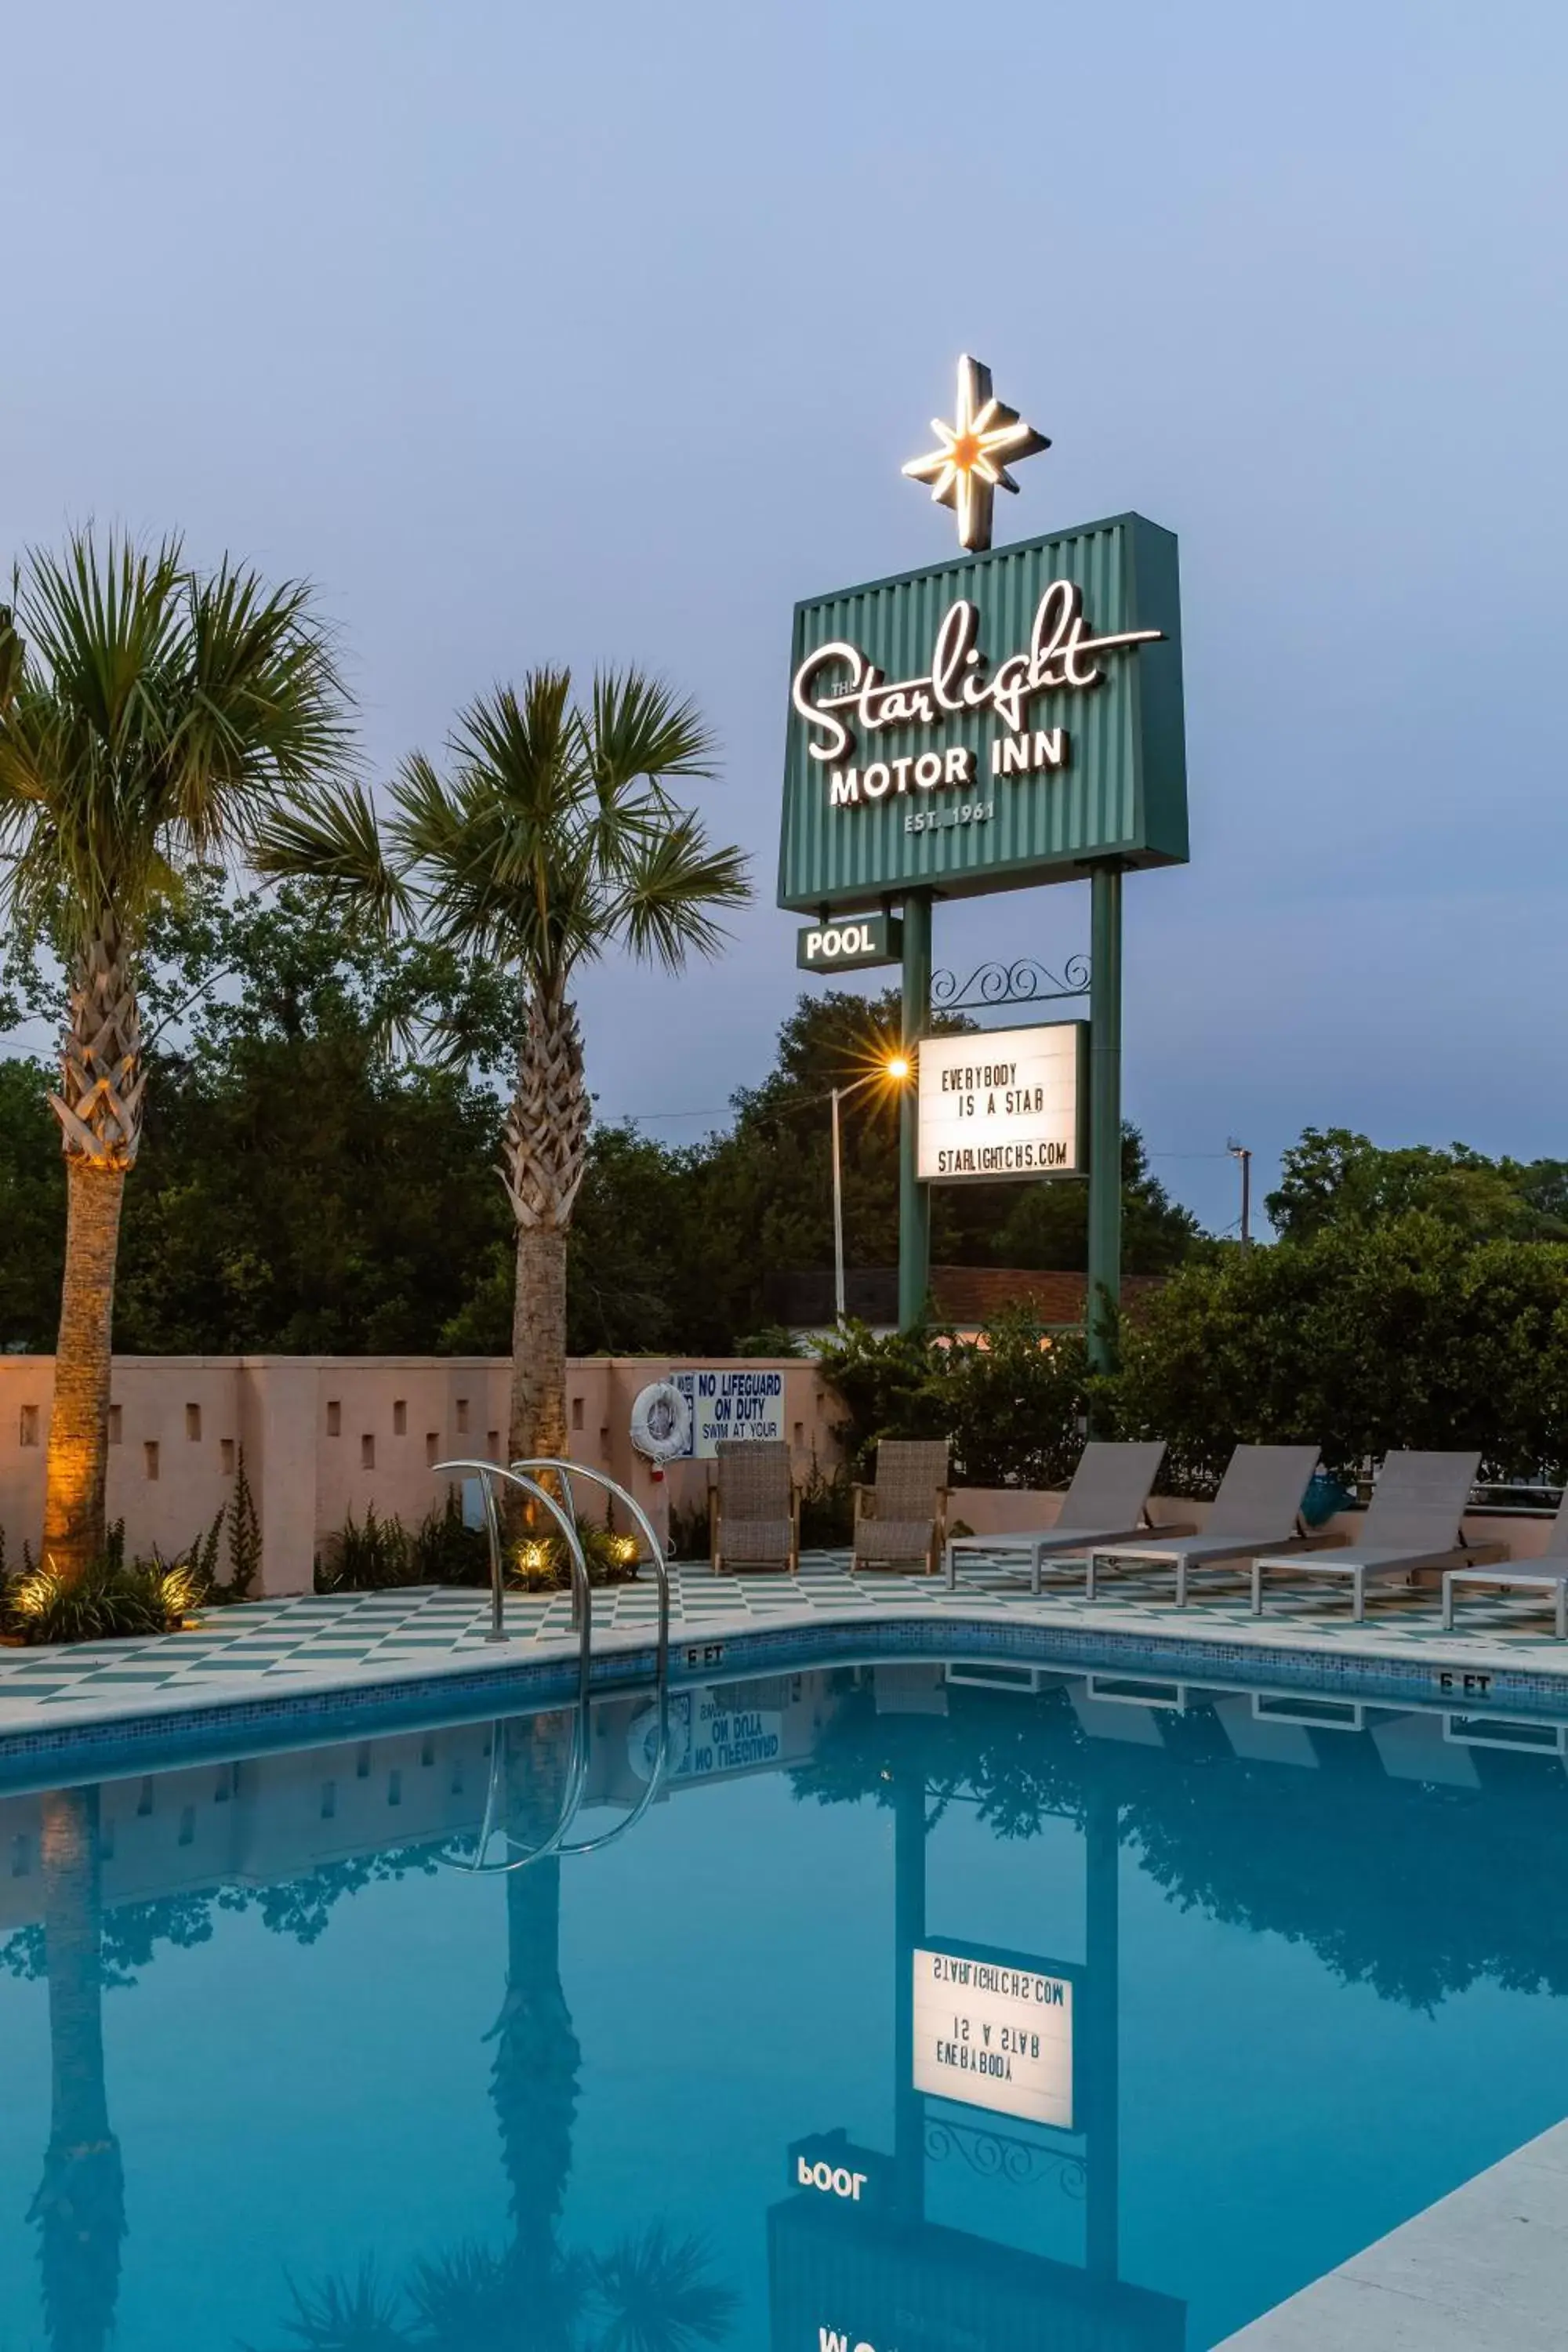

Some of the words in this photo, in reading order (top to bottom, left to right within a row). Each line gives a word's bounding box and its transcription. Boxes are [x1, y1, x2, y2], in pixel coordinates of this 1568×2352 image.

[793, 579, 1162, 760] Starlight
[829, 746, 969, 806] MOTOR
[992, 728, 1062, 775] INN
[905, 811, 942, 833] EST.
[953, 800, 995, 824] 1961
[807, 924, 876, 960] POOL
[942, 1062, 1017, 1092] EVERYBODY
[959, 1094, 975, 1117] IS
[987, 1092, 996, 1114] A
[1005, 1087, 1044, 1115] STAR
[938, 1141, 1067, 1174] STARLIGHTCHS.COM
[699, 1374, 716, 1397] NO
[722, 1374, 782, 1396] LIFEGUARD
[714, 1398, 731, 1421] ON
[736, 1397, 766, 1420] DUTY
[702, 1423, 728, 1439] SWIM
[733, 1422, 746, 1438] AT
[750, 1421, 777, 1437] YOUR
